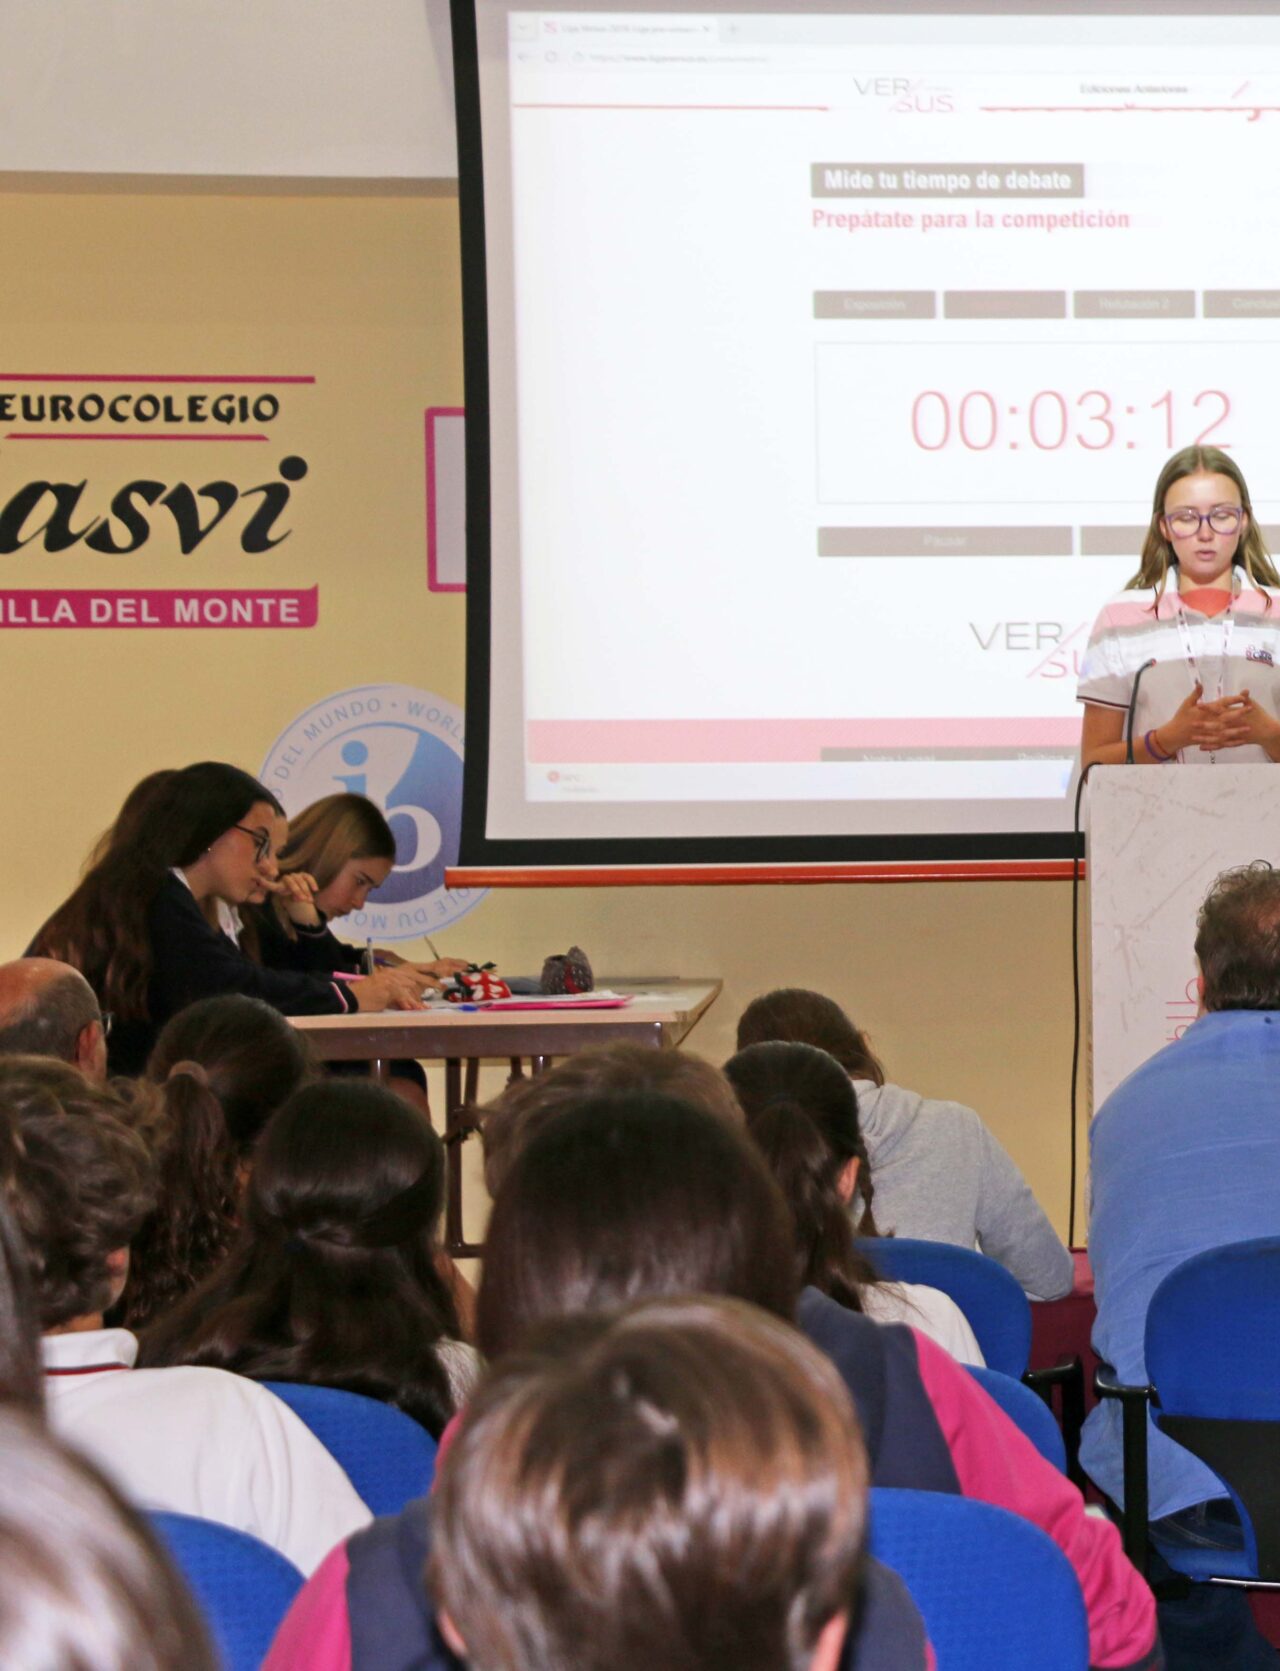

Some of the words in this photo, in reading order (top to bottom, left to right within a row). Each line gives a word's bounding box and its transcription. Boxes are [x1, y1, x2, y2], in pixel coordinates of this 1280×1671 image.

[852, 77, 911, 96] VER
[824, 169, 874, 190] Mide
[879, 169, 898, 190] tu
[903, 168, 971, 194] tiempo
[976, 168, 1000, 190] de
[1005, 168, 1072, 190] debate
[812, 208, 914, 233] Prepátate
[921, 213, 968, 232] para
[975, 209, 994, 228] la
[1001, 208, 1131, 233] competición
[0, 393, 280, 425] EUROCOLEGIO
[911, 389, 1233, 451] 00:03:12
[90, 598, 160, 623] DEL
[174, 598, 300, 624] MONTE
[968, 621, 1064, 650] VER
[274, 745, 307, 782] DEL
[303, 697, 381, 743] MUNDO
[407, 699, 465, 746] WORL
